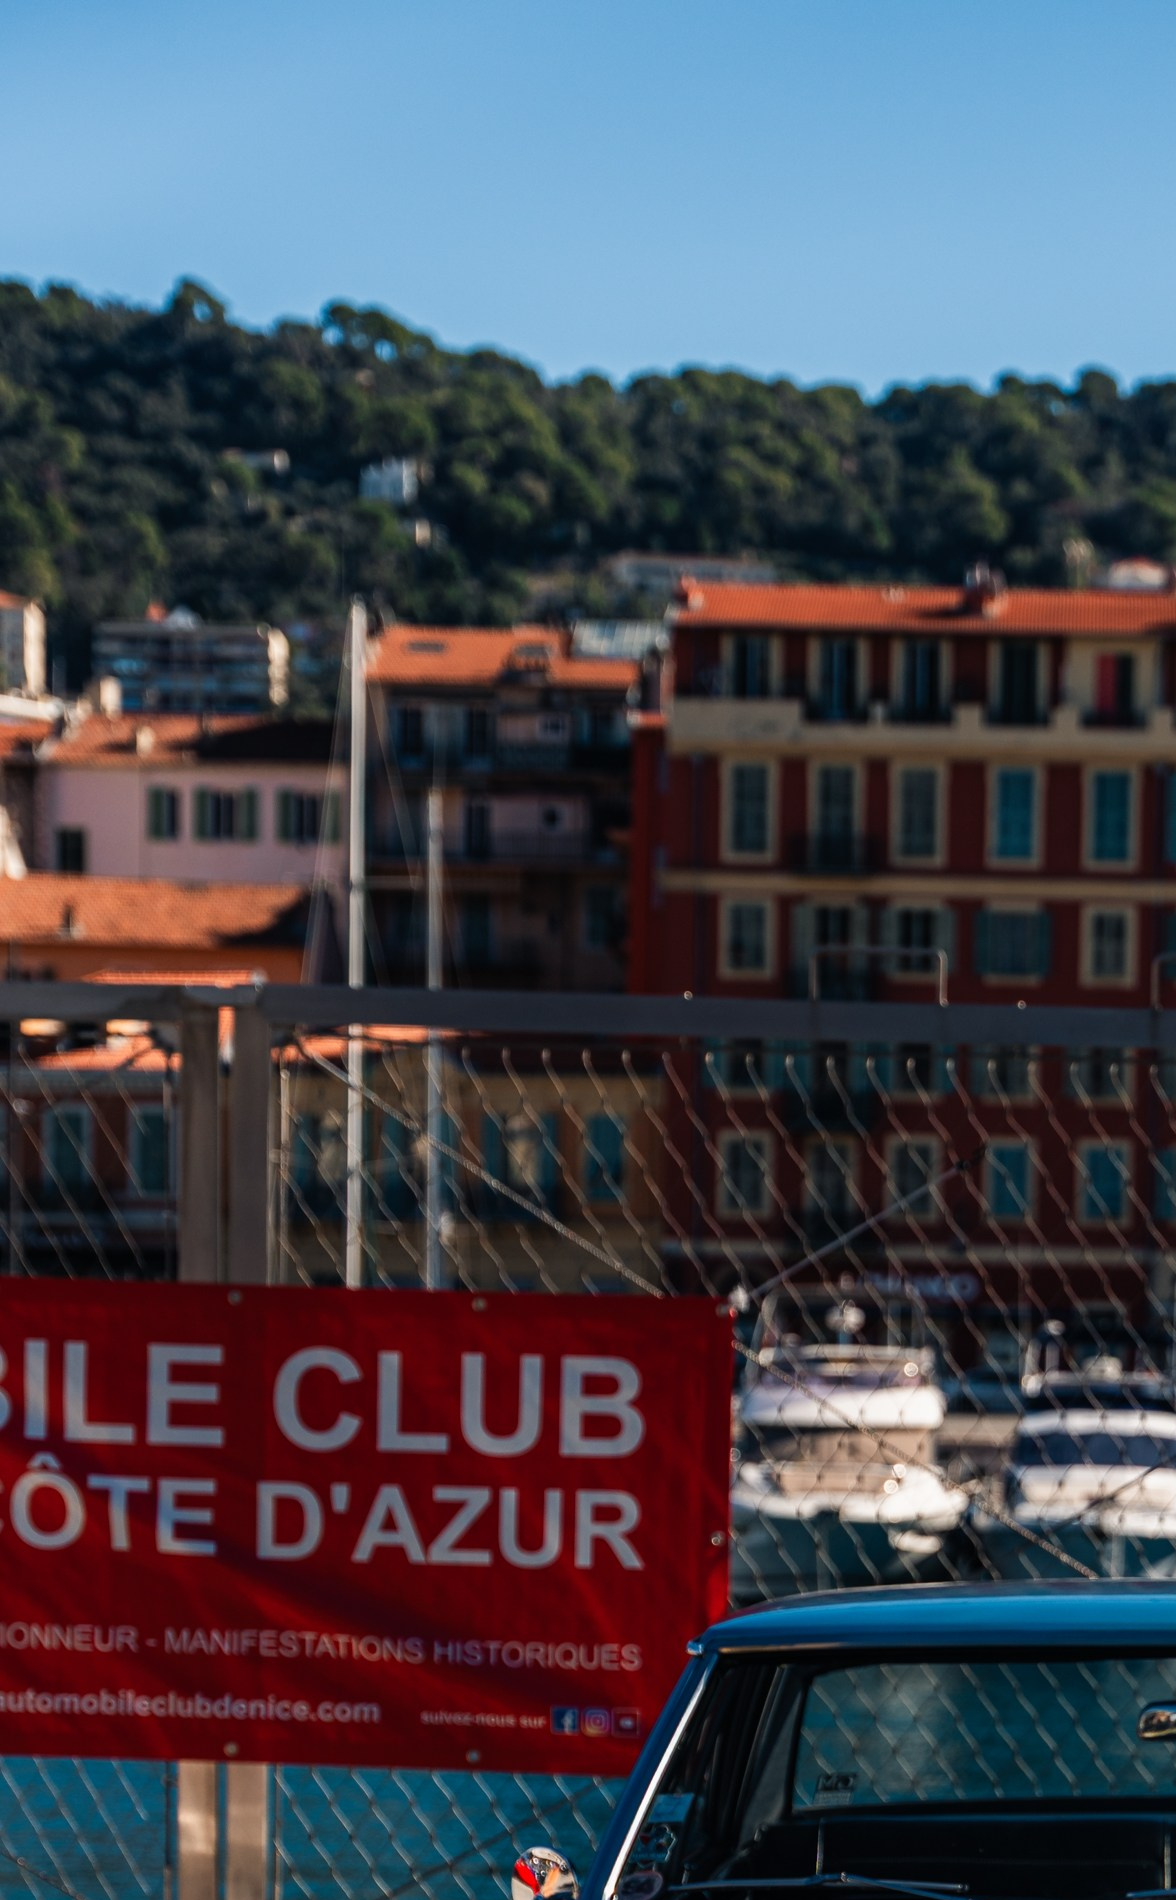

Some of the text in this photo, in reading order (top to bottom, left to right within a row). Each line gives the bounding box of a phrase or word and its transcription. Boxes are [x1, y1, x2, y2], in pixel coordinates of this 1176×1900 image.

[0, 1336, 645, 1458] ILE CLUB
[0, 1451, 645, 1572] ÔTE D'AZUR
[164, 1626, 425, 1665] MANIFESTATIONS
[433, 1639, 643, 1672] HISTORIQUES
